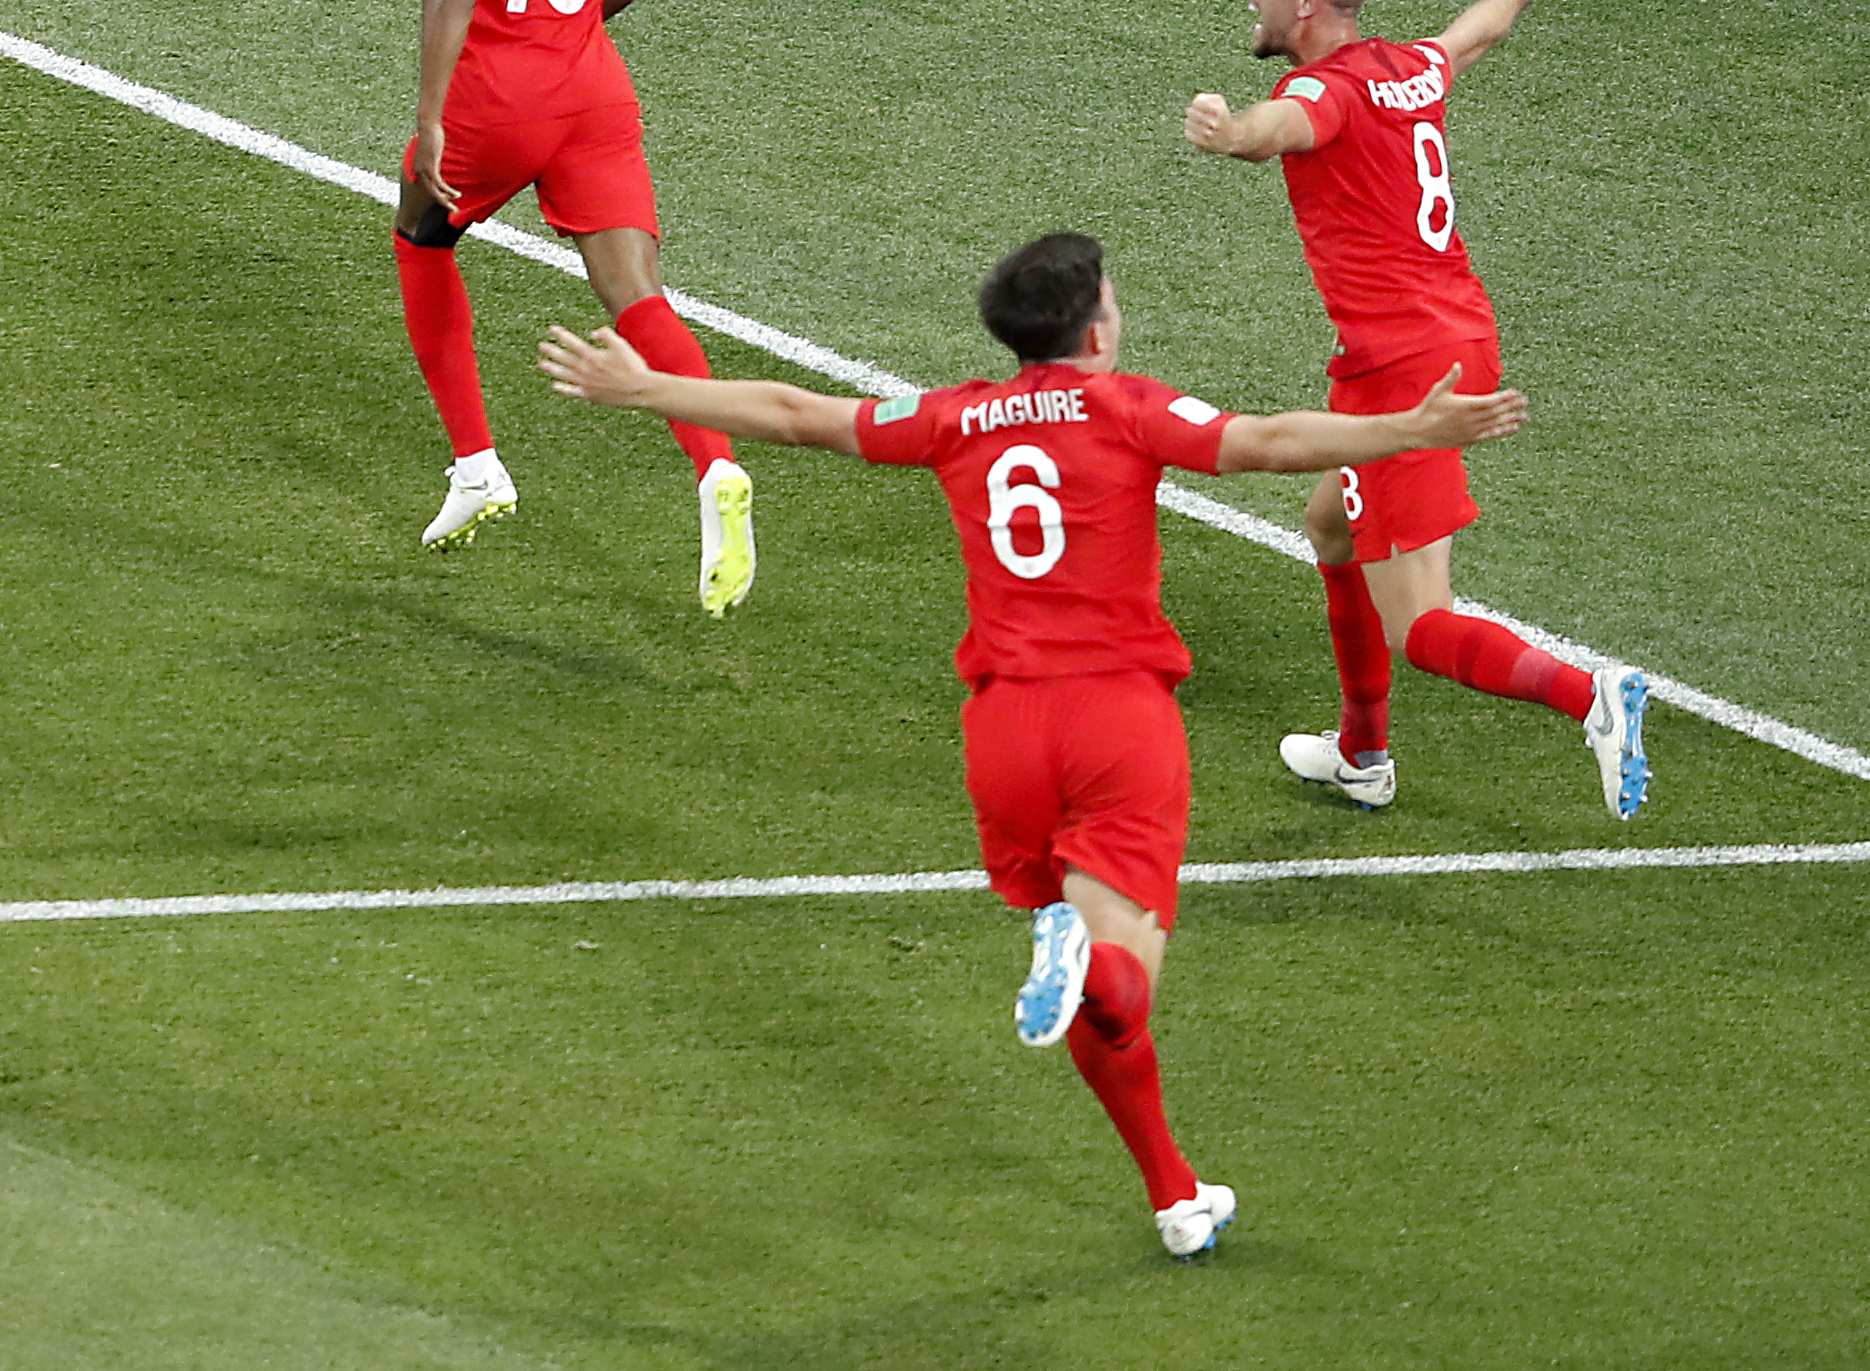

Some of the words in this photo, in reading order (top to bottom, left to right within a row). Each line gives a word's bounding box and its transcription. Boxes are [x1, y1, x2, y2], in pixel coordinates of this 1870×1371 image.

[1413, 121, 1456, 252] 8
[960, 388, 1090, 435] MAGUIRE
[987, 445, 1066, 579] 6
